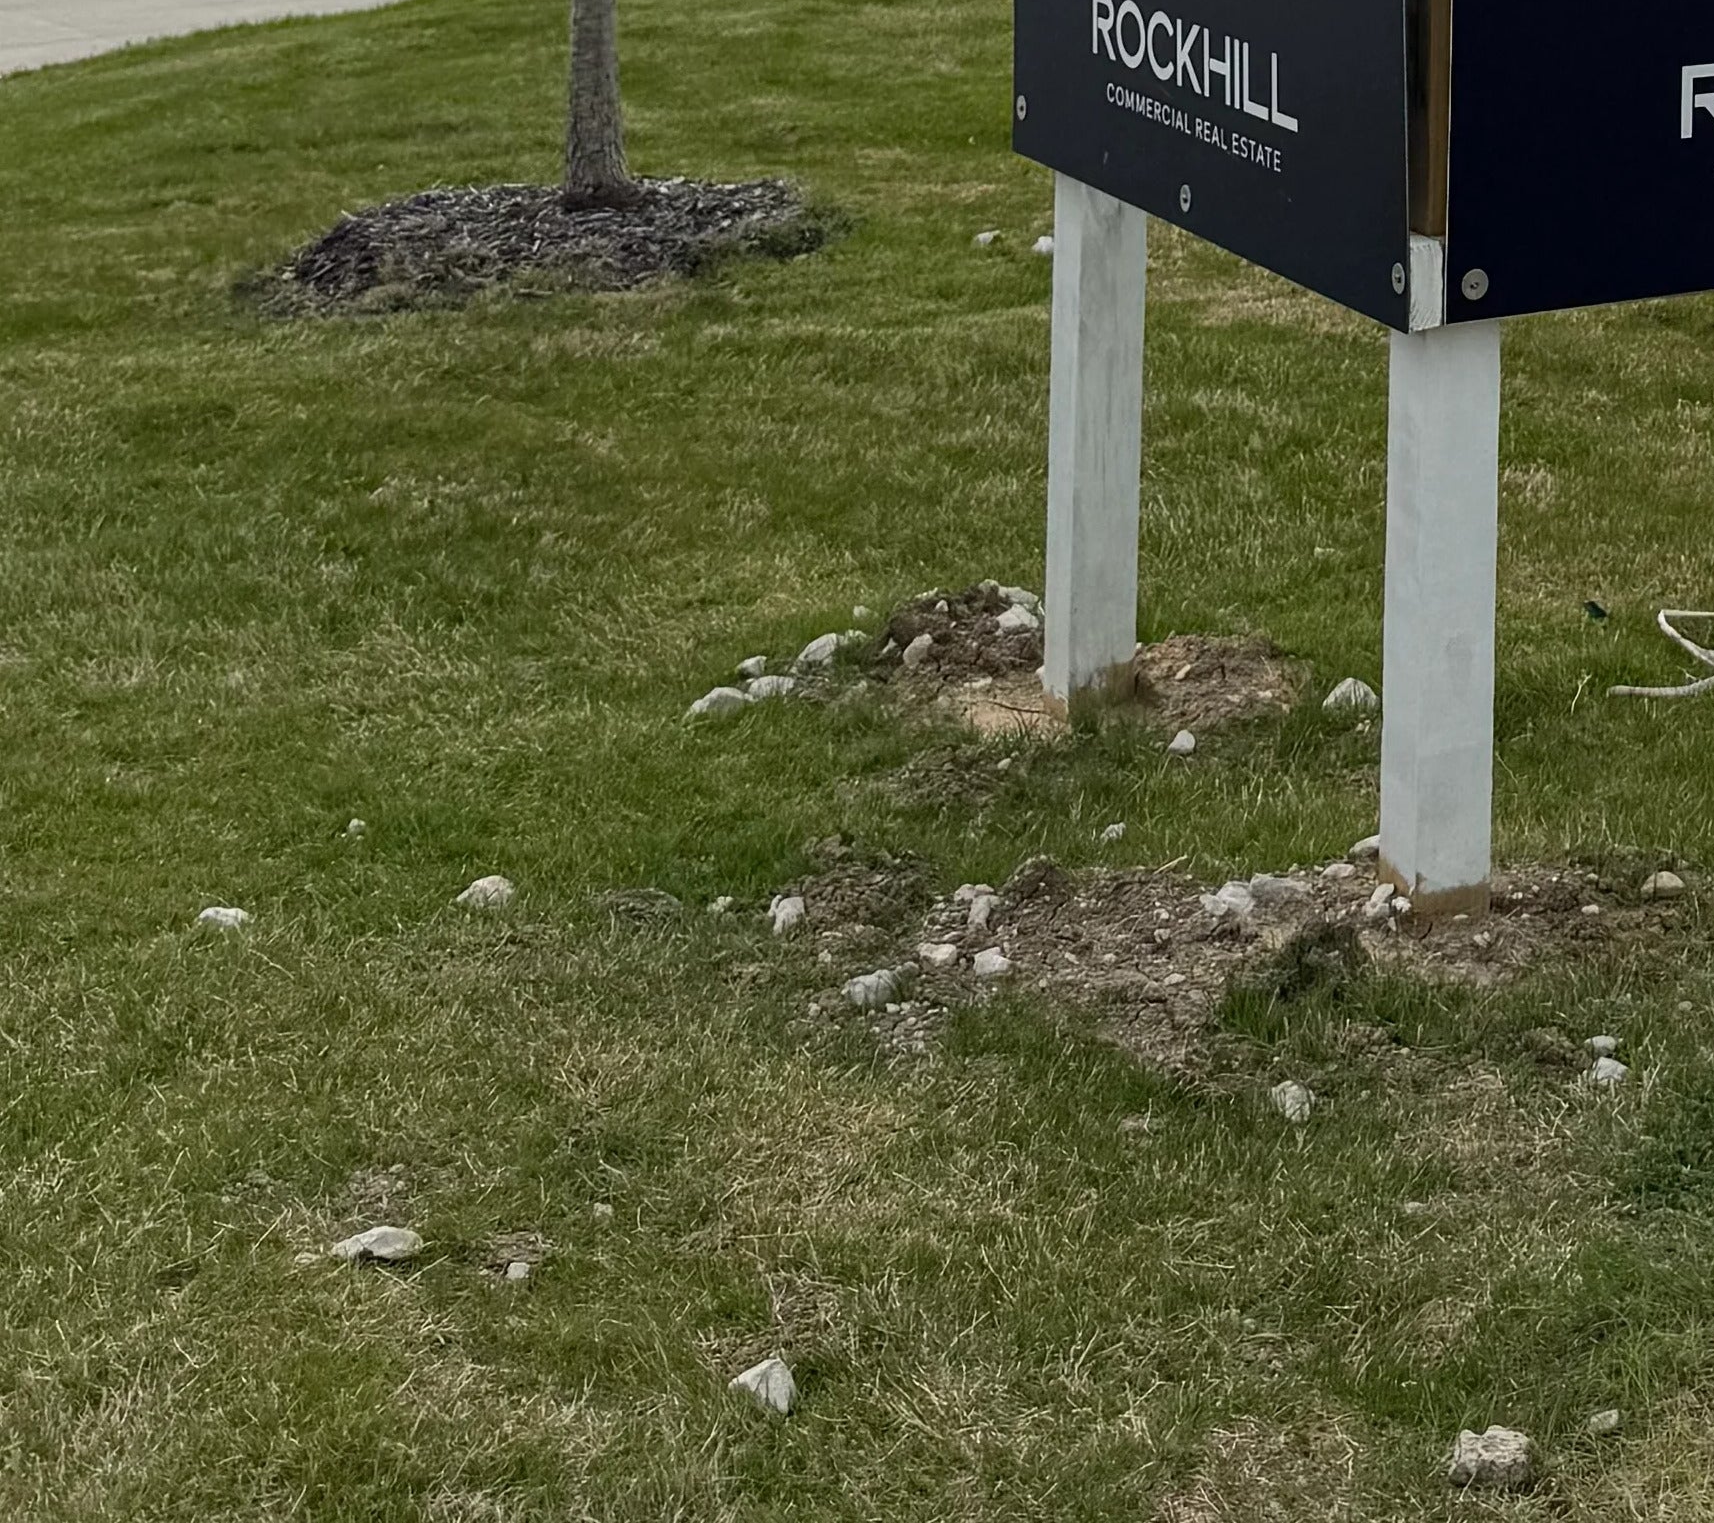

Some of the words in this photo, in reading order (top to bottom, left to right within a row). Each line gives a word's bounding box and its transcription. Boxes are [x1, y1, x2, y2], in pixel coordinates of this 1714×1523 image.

[1106, 81, 1192, 135] COMMERCIAL
[1195, 121, 1228, 151] REAL
[1231, 132, 1282, 173] ESTATE
